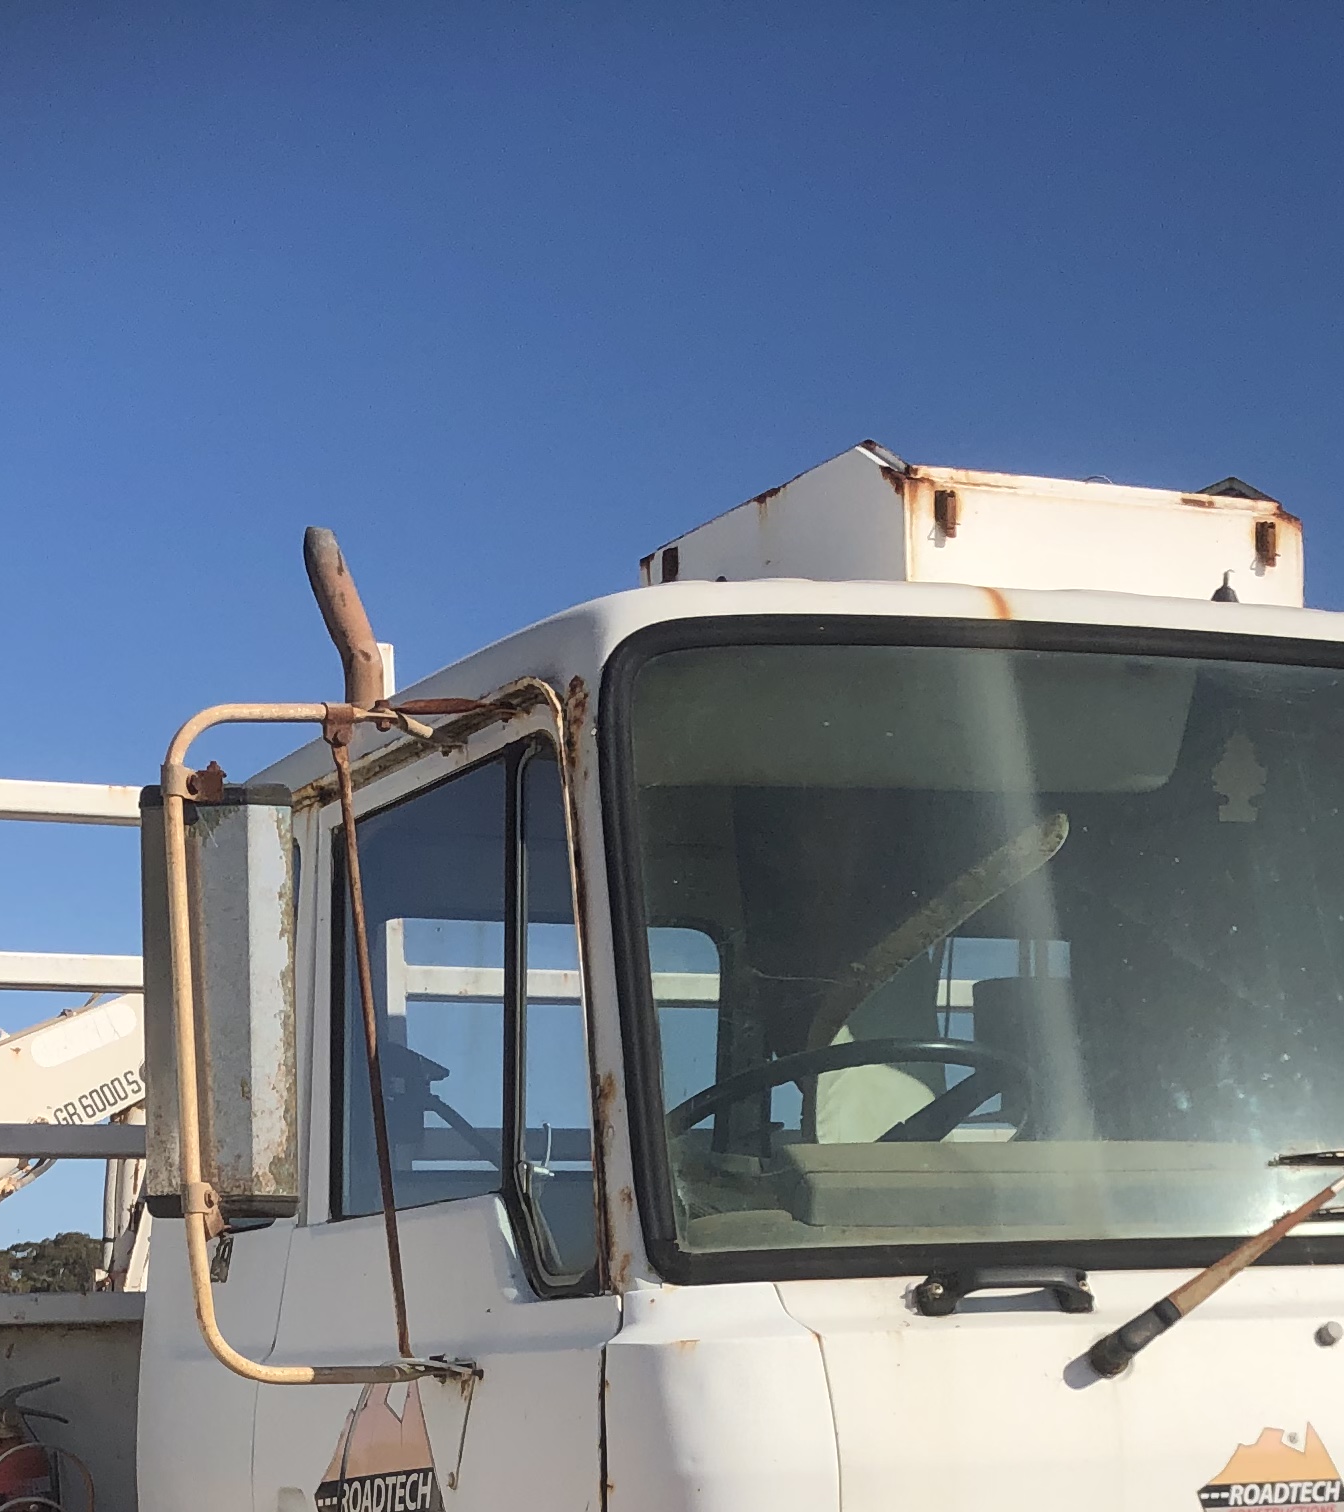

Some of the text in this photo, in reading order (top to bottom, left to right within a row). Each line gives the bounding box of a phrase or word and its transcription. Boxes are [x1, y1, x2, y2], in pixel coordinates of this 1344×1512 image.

[53, 1070, 142, 1125] GR 6000 S
[1228, 1480, 1342, 1506] ROADTECH
